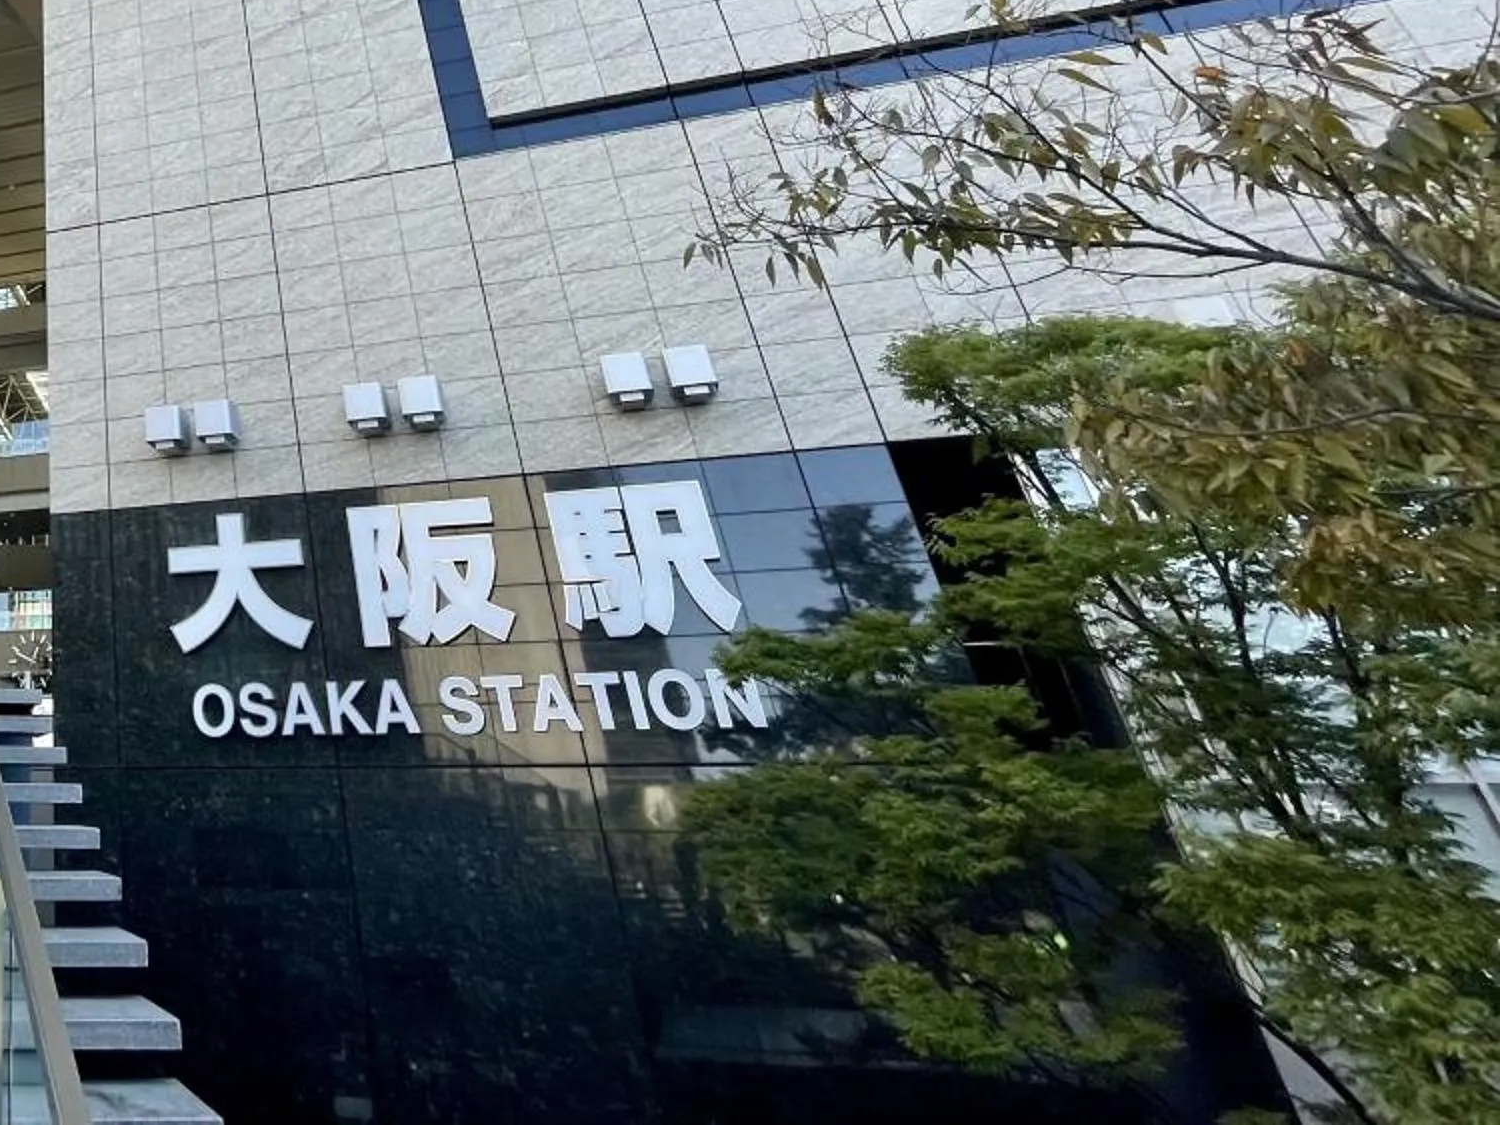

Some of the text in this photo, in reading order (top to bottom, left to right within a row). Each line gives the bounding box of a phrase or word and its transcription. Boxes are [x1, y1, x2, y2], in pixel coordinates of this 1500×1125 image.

[168, 479, 743, 654] 大阪駅
[192, 668, 769, 739] OSAKA STATION
